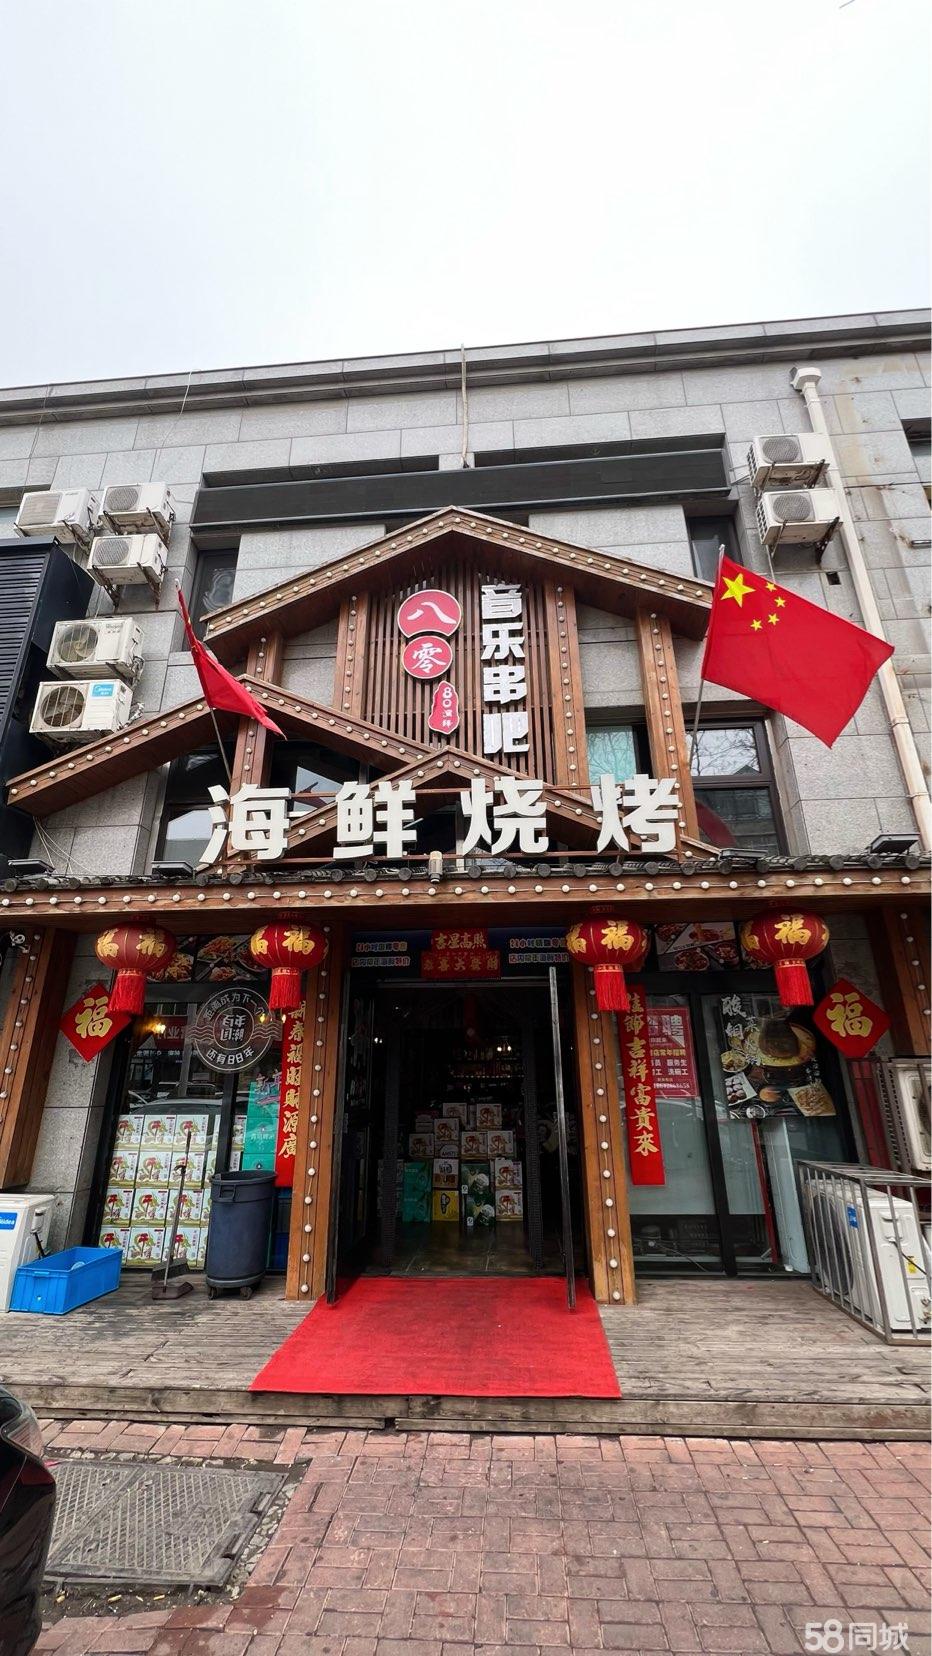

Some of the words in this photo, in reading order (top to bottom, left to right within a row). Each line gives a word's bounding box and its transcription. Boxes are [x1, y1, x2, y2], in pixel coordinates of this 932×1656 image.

[407, 601, 457, 674] 八零
[481, 583, 529, 753] 音乐串吧
[198, 774, 680, 865] 海鲜烧烤
[136, 929, 167, 958] 福
[283, 925, 315, 955] 福
[435, 932, 487, 951] 吉星高照
[601, 919, 634, 951] 福
[774, 913, 811, 945] 福
[75, 995, 113, 1039] 福
[222, 1013, 247, 1028] 百年
[826, 992, 873, 1037] 福
[205, 1046, 255, 1065] 还有88年
[650, 1049, 687, 1057] 店常年招聘
